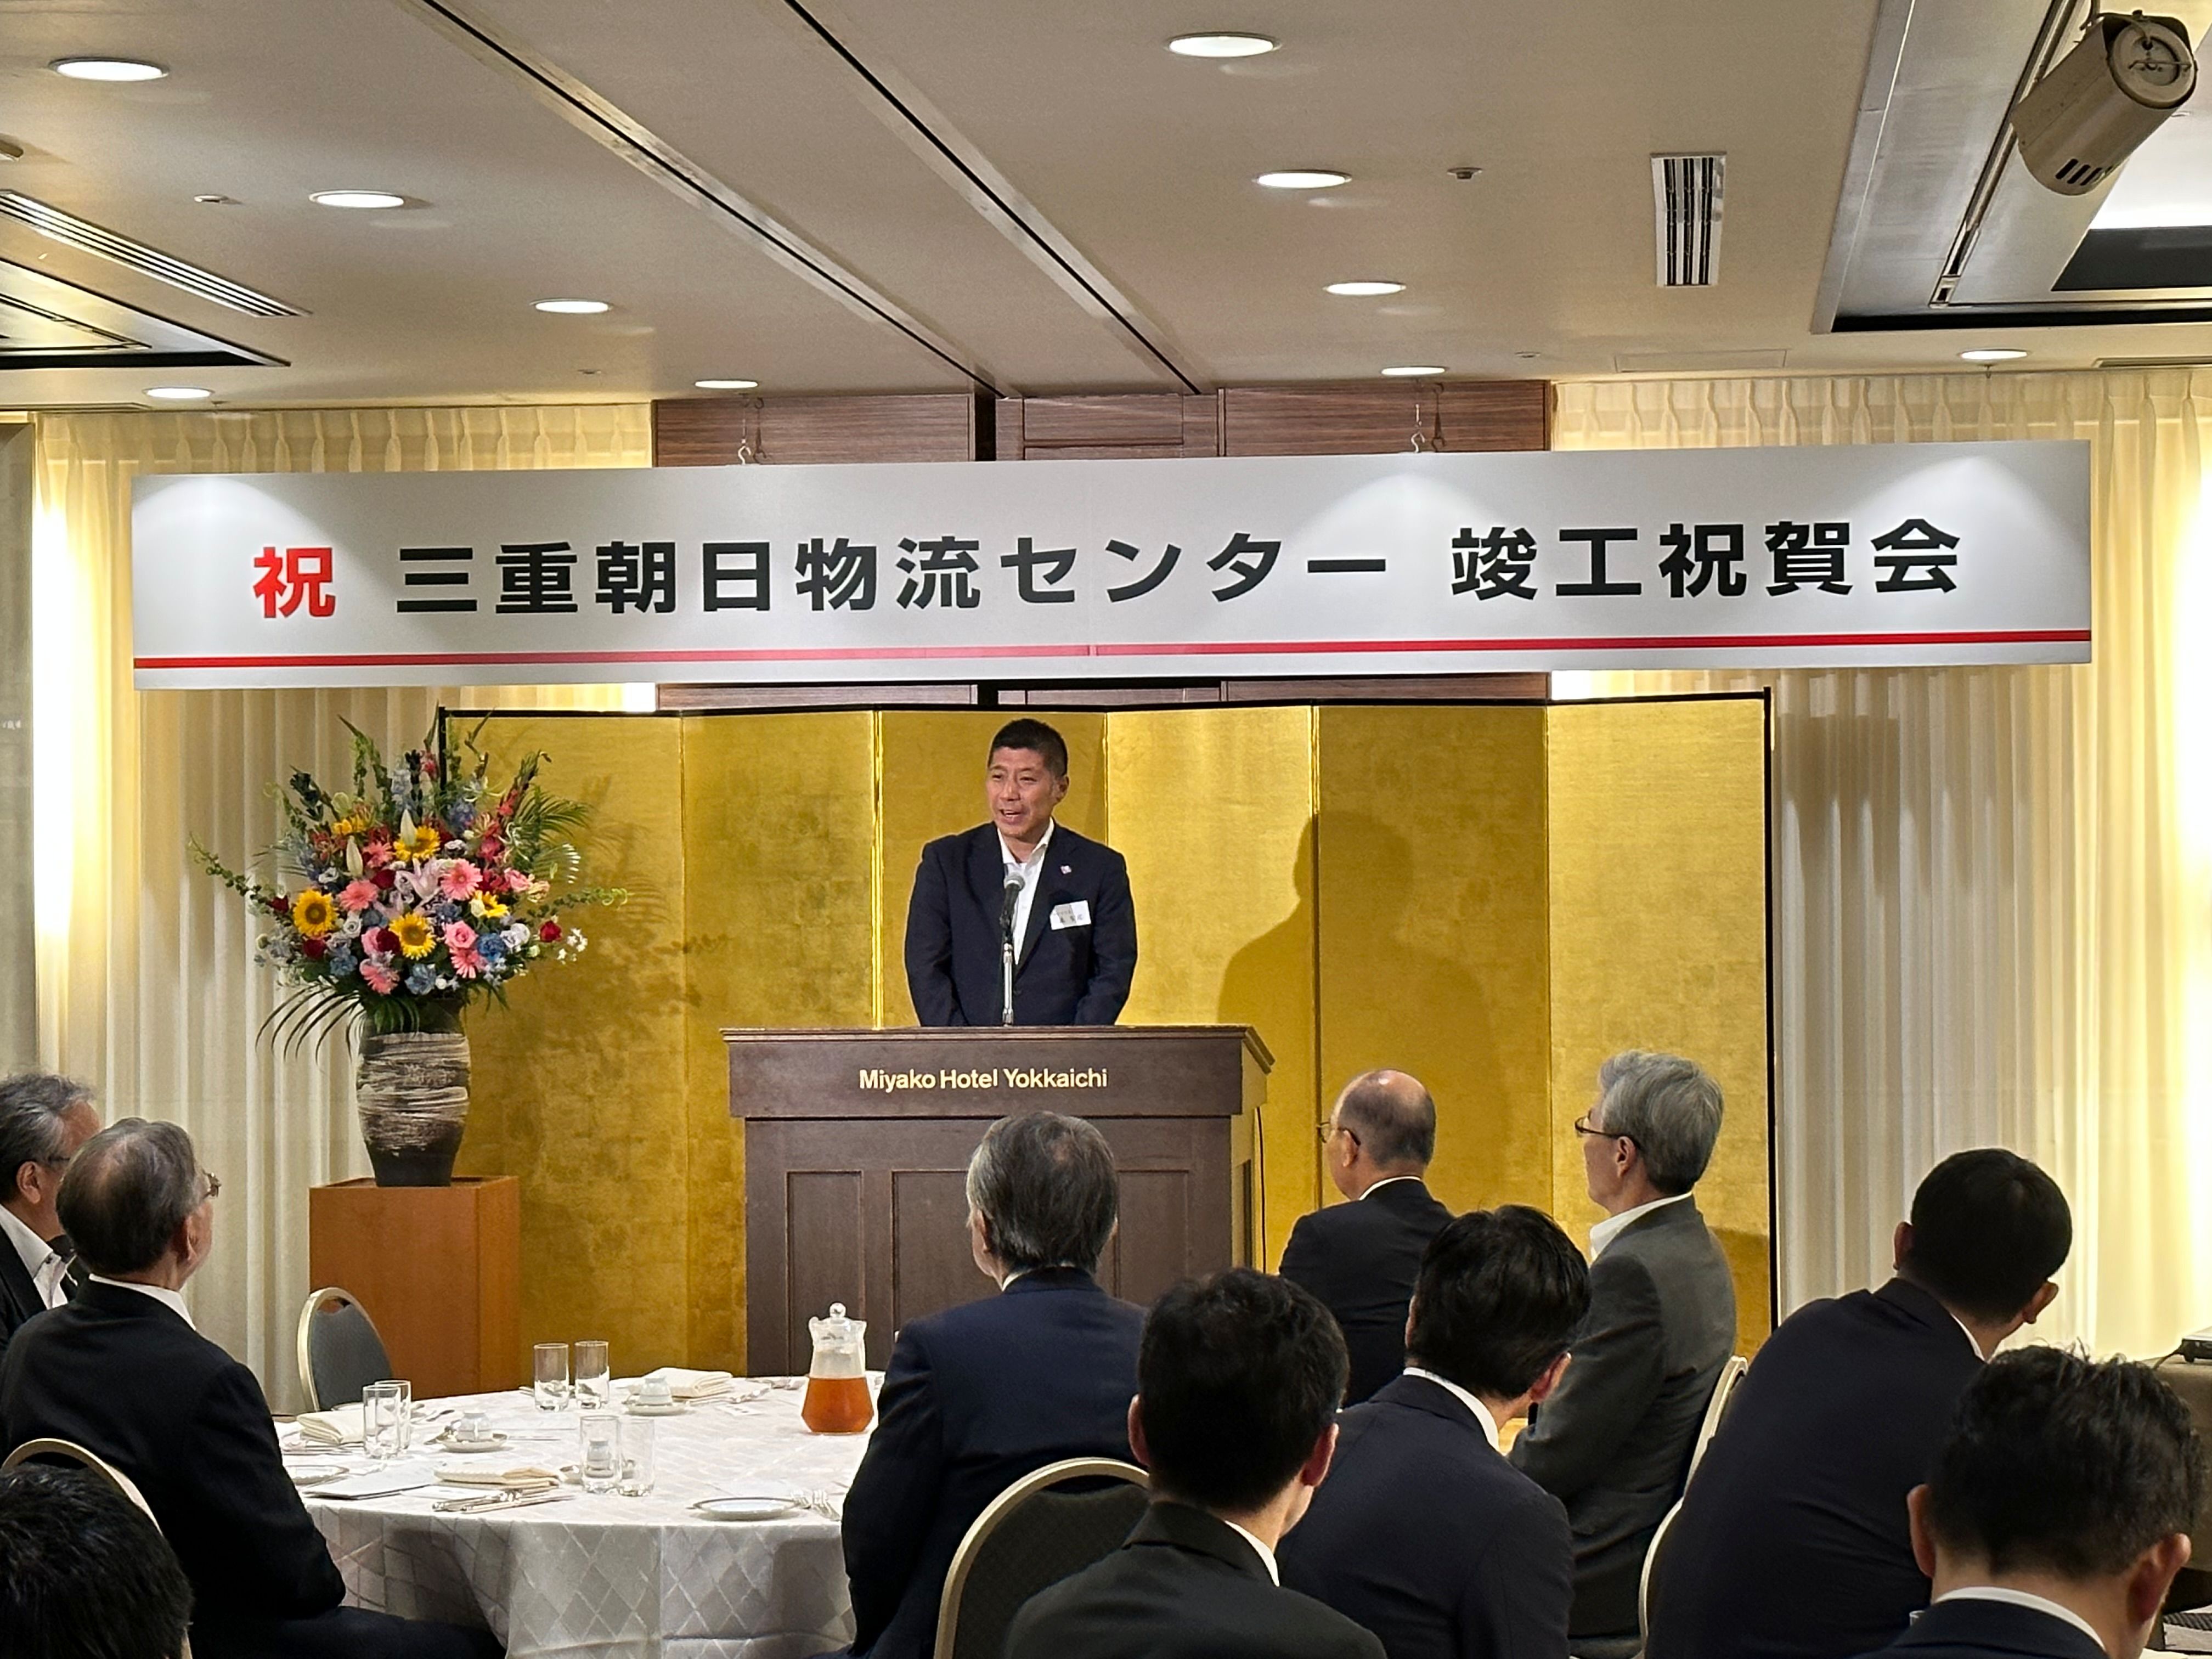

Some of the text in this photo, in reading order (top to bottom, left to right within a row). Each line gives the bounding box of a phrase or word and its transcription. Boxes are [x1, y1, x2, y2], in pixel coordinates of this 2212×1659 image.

[252, 519, 1960, 618] 祝 三重朝日物流センター 竣工祝賀会
[859, 1067, 1107, 1093] Miyako Hotel Yokkaichi
